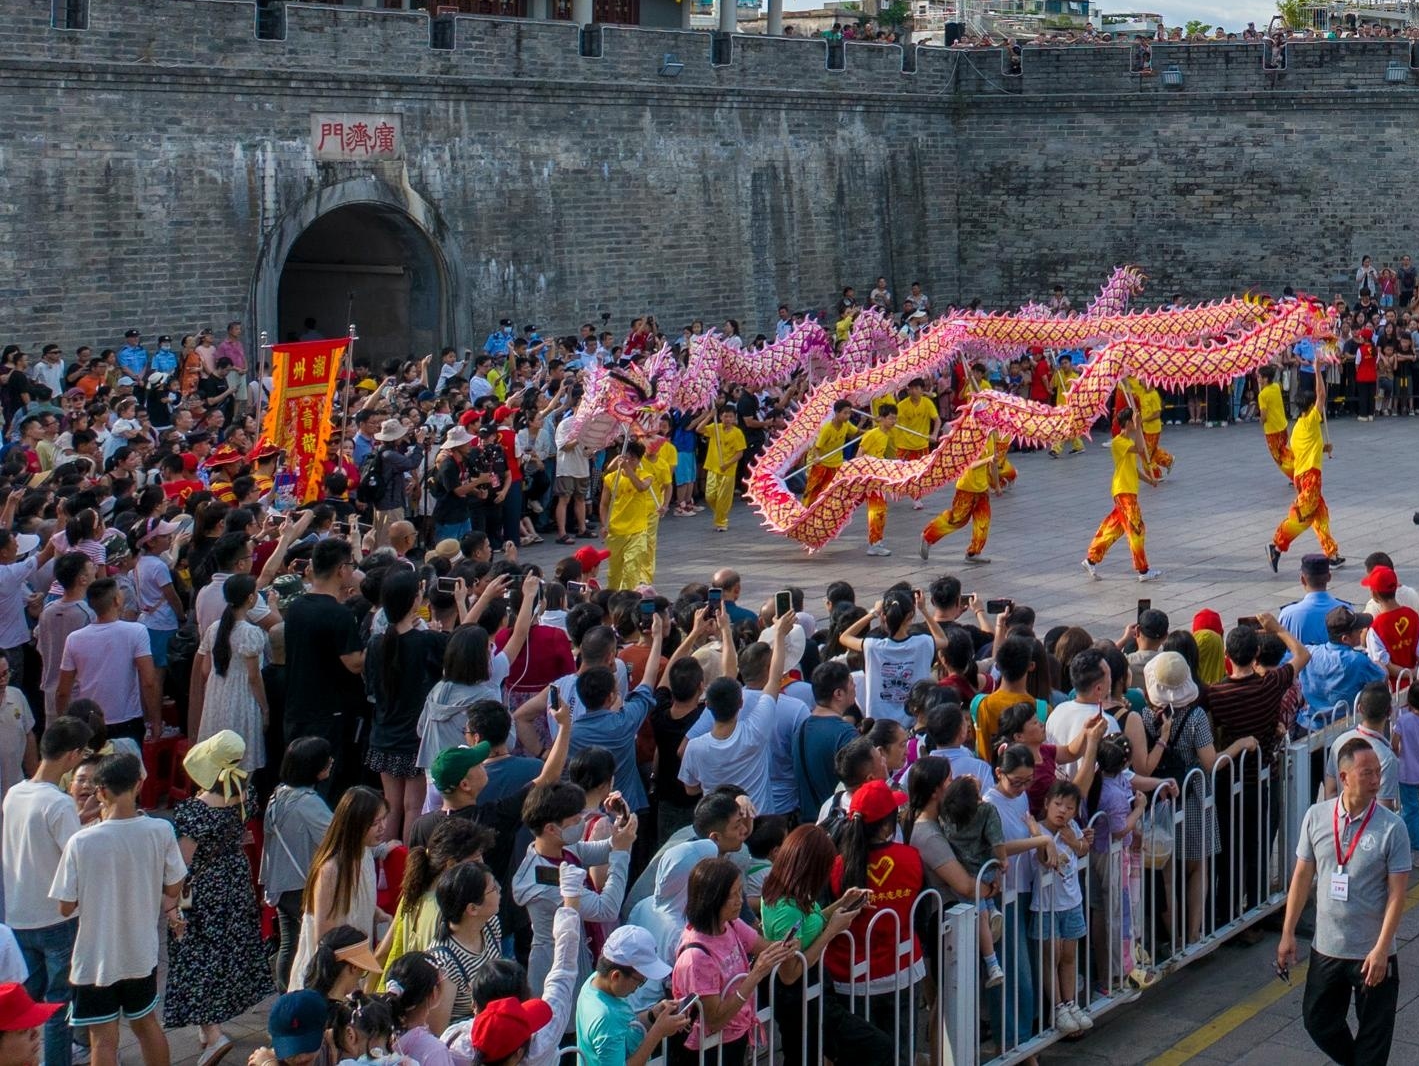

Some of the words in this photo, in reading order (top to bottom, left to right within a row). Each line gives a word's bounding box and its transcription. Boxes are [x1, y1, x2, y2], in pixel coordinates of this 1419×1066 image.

[318, 121, 395, 154] 廣濟門
[293, 355, 326, 381] 潮州
